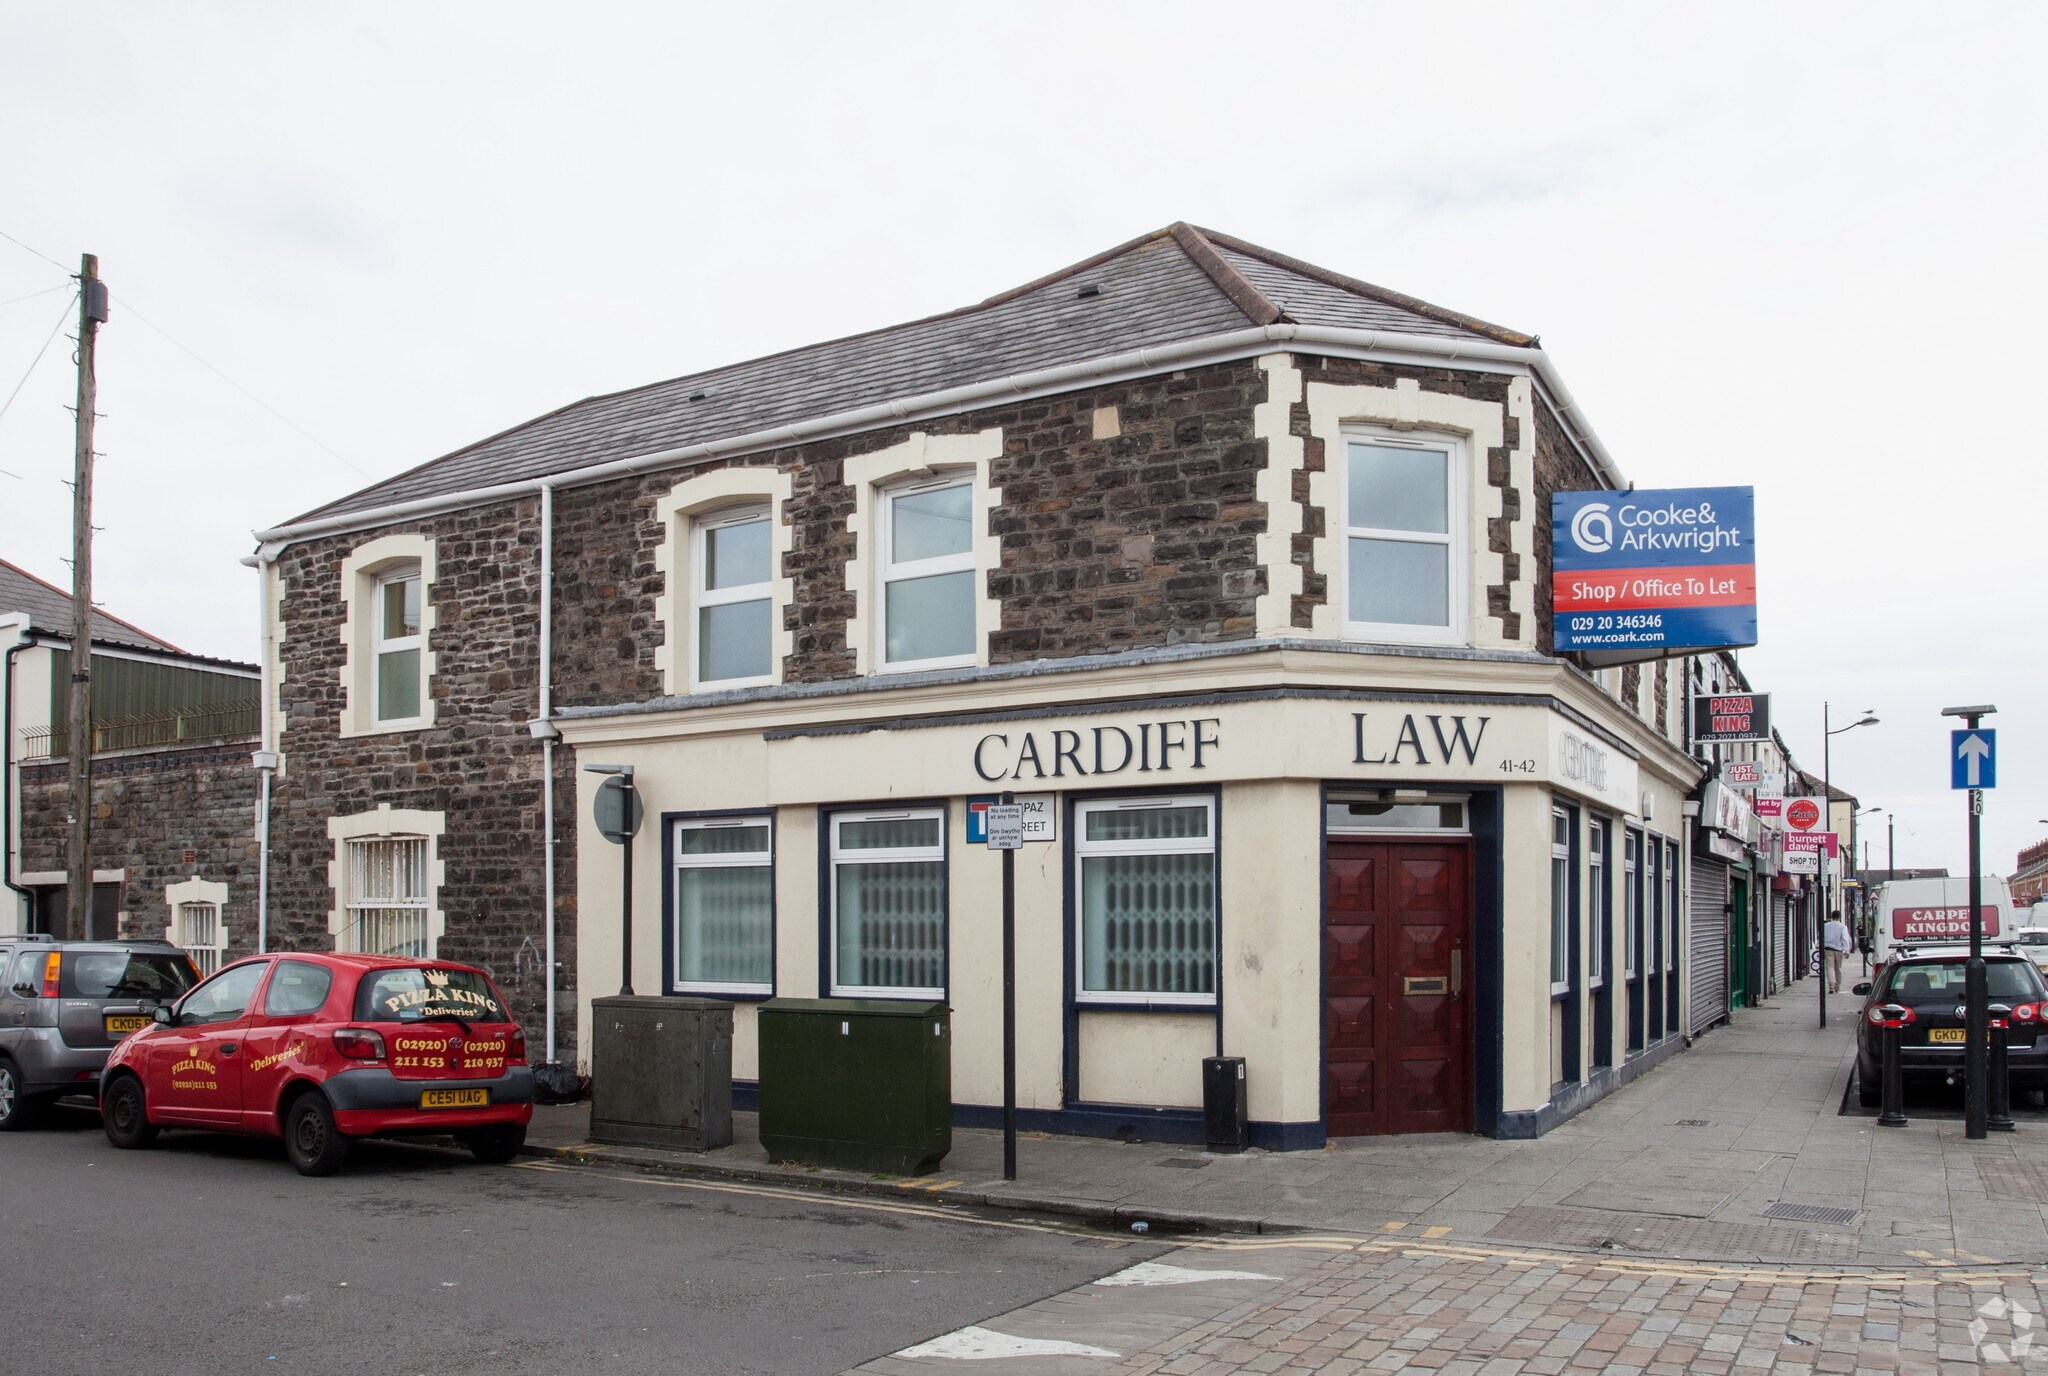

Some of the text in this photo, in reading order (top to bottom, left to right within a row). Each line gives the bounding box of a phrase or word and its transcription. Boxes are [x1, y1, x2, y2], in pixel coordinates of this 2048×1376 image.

[1618, 502, 1716, 527] Cooke&
[1619, 525, 1741, 553] Arkwright
[1572, 582, 1616, 603] Shop
[1632, 578, 1682, 597] Office
[1685, 578, 1705, 596] To
[1709, 577, 1736, 595] Let
[1571, 615, 1662, 631] 029 20 346346
[1571, 632, 1665, 644] www.coark.com
[1710, 697, 1753, 715] PIZZA
[1712, 715, 1750, 733] KING
[974, 712, 1491, 782] CARDIFF LAW
[1499, 760, 1535, 773] 41-42
[1728, 765, 1752, 774] JUST
[1734, 773, 1752, 781] EAT
[1017, 802, 1044, 812] PAZ
[1022, 822, 1046, 831] REET
[1788, 832, 1827, 843] burnett
[1789, 856, 1806, 865] SHOP
[385, 988, 498, 1012] PIZZA KING
[112, 1018, 142, 1030] CK06
[395, 1037, 448, 1053] (02920)
[463, 1040, 506, 1054] (02920)
[172, 1060, 216, 1075] PIZZA KING
[394, 1057, 445, 1067] 211 153
[464, 1057, 504, 1068] 210 937
[206, 1080, 218, 1090] 153
[429, 1090, 482, 1104] CE51 UAG
